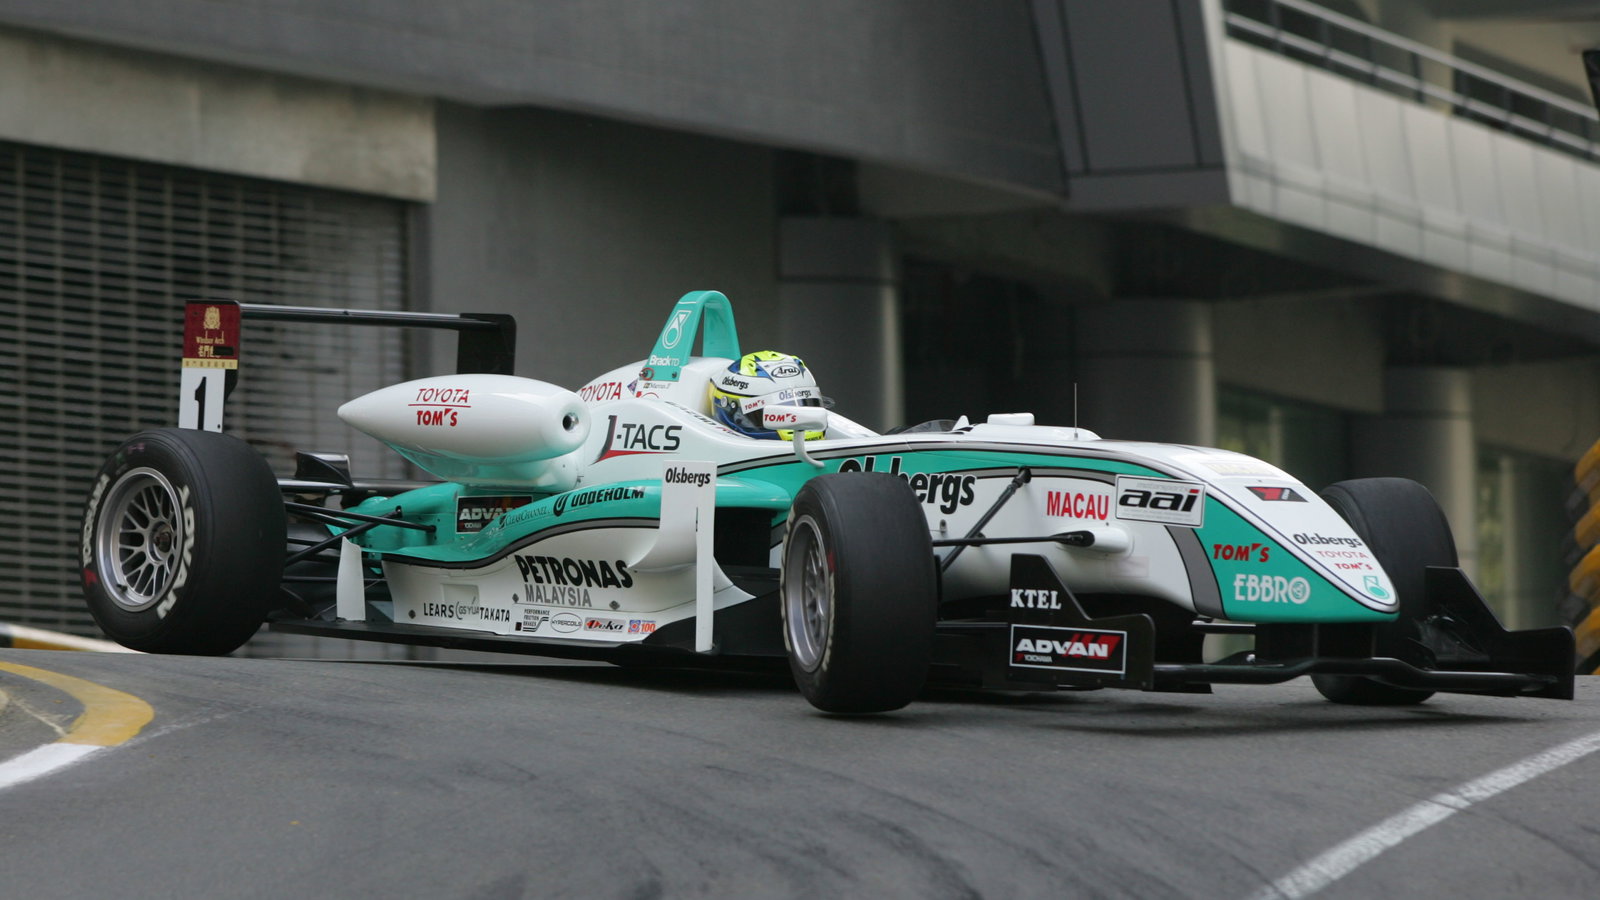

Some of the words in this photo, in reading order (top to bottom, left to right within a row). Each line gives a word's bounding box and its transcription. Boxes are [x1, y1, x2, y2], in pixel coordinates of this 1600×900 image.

[778, 366, 798, 375] Arai
[580, 382, 622, 402] TOYOTA
[721, 376, 749, 390] Olsbergs
[194, 376, 207, 430] 1
[416, 388, 470, 403] TOYOTA
[744, 400, 766, 411] TOM'S
[416, 408, 458, 427] TOM'S
[764, 413, 798, 423] TOM'S
[665, 466, 711, 488] Olsbergs
[1047, 491, 1109, 520] MACAU
[1118, 489, 1200, 513] aai
[1293, 533, 1363, 548] Olsbergs
[1213, 543, 1270, 563] TOM'S
[1316, 551, 1369, 559] TOYOTA
[514, 554, 633, 588] PETRONAS
[1335, 562, 1373, 570] TOM'S
[525, 584, 592, 608] MALAYSIA
[1233, 573, 1311, 604] EBBRO
[1010, 588, 1062, 610] KTEL
[423, 602, 455, 619] LEARS
[480, 606, 510, 622] TAKATA
[1016, 638, 1109, 657] ADVAN
